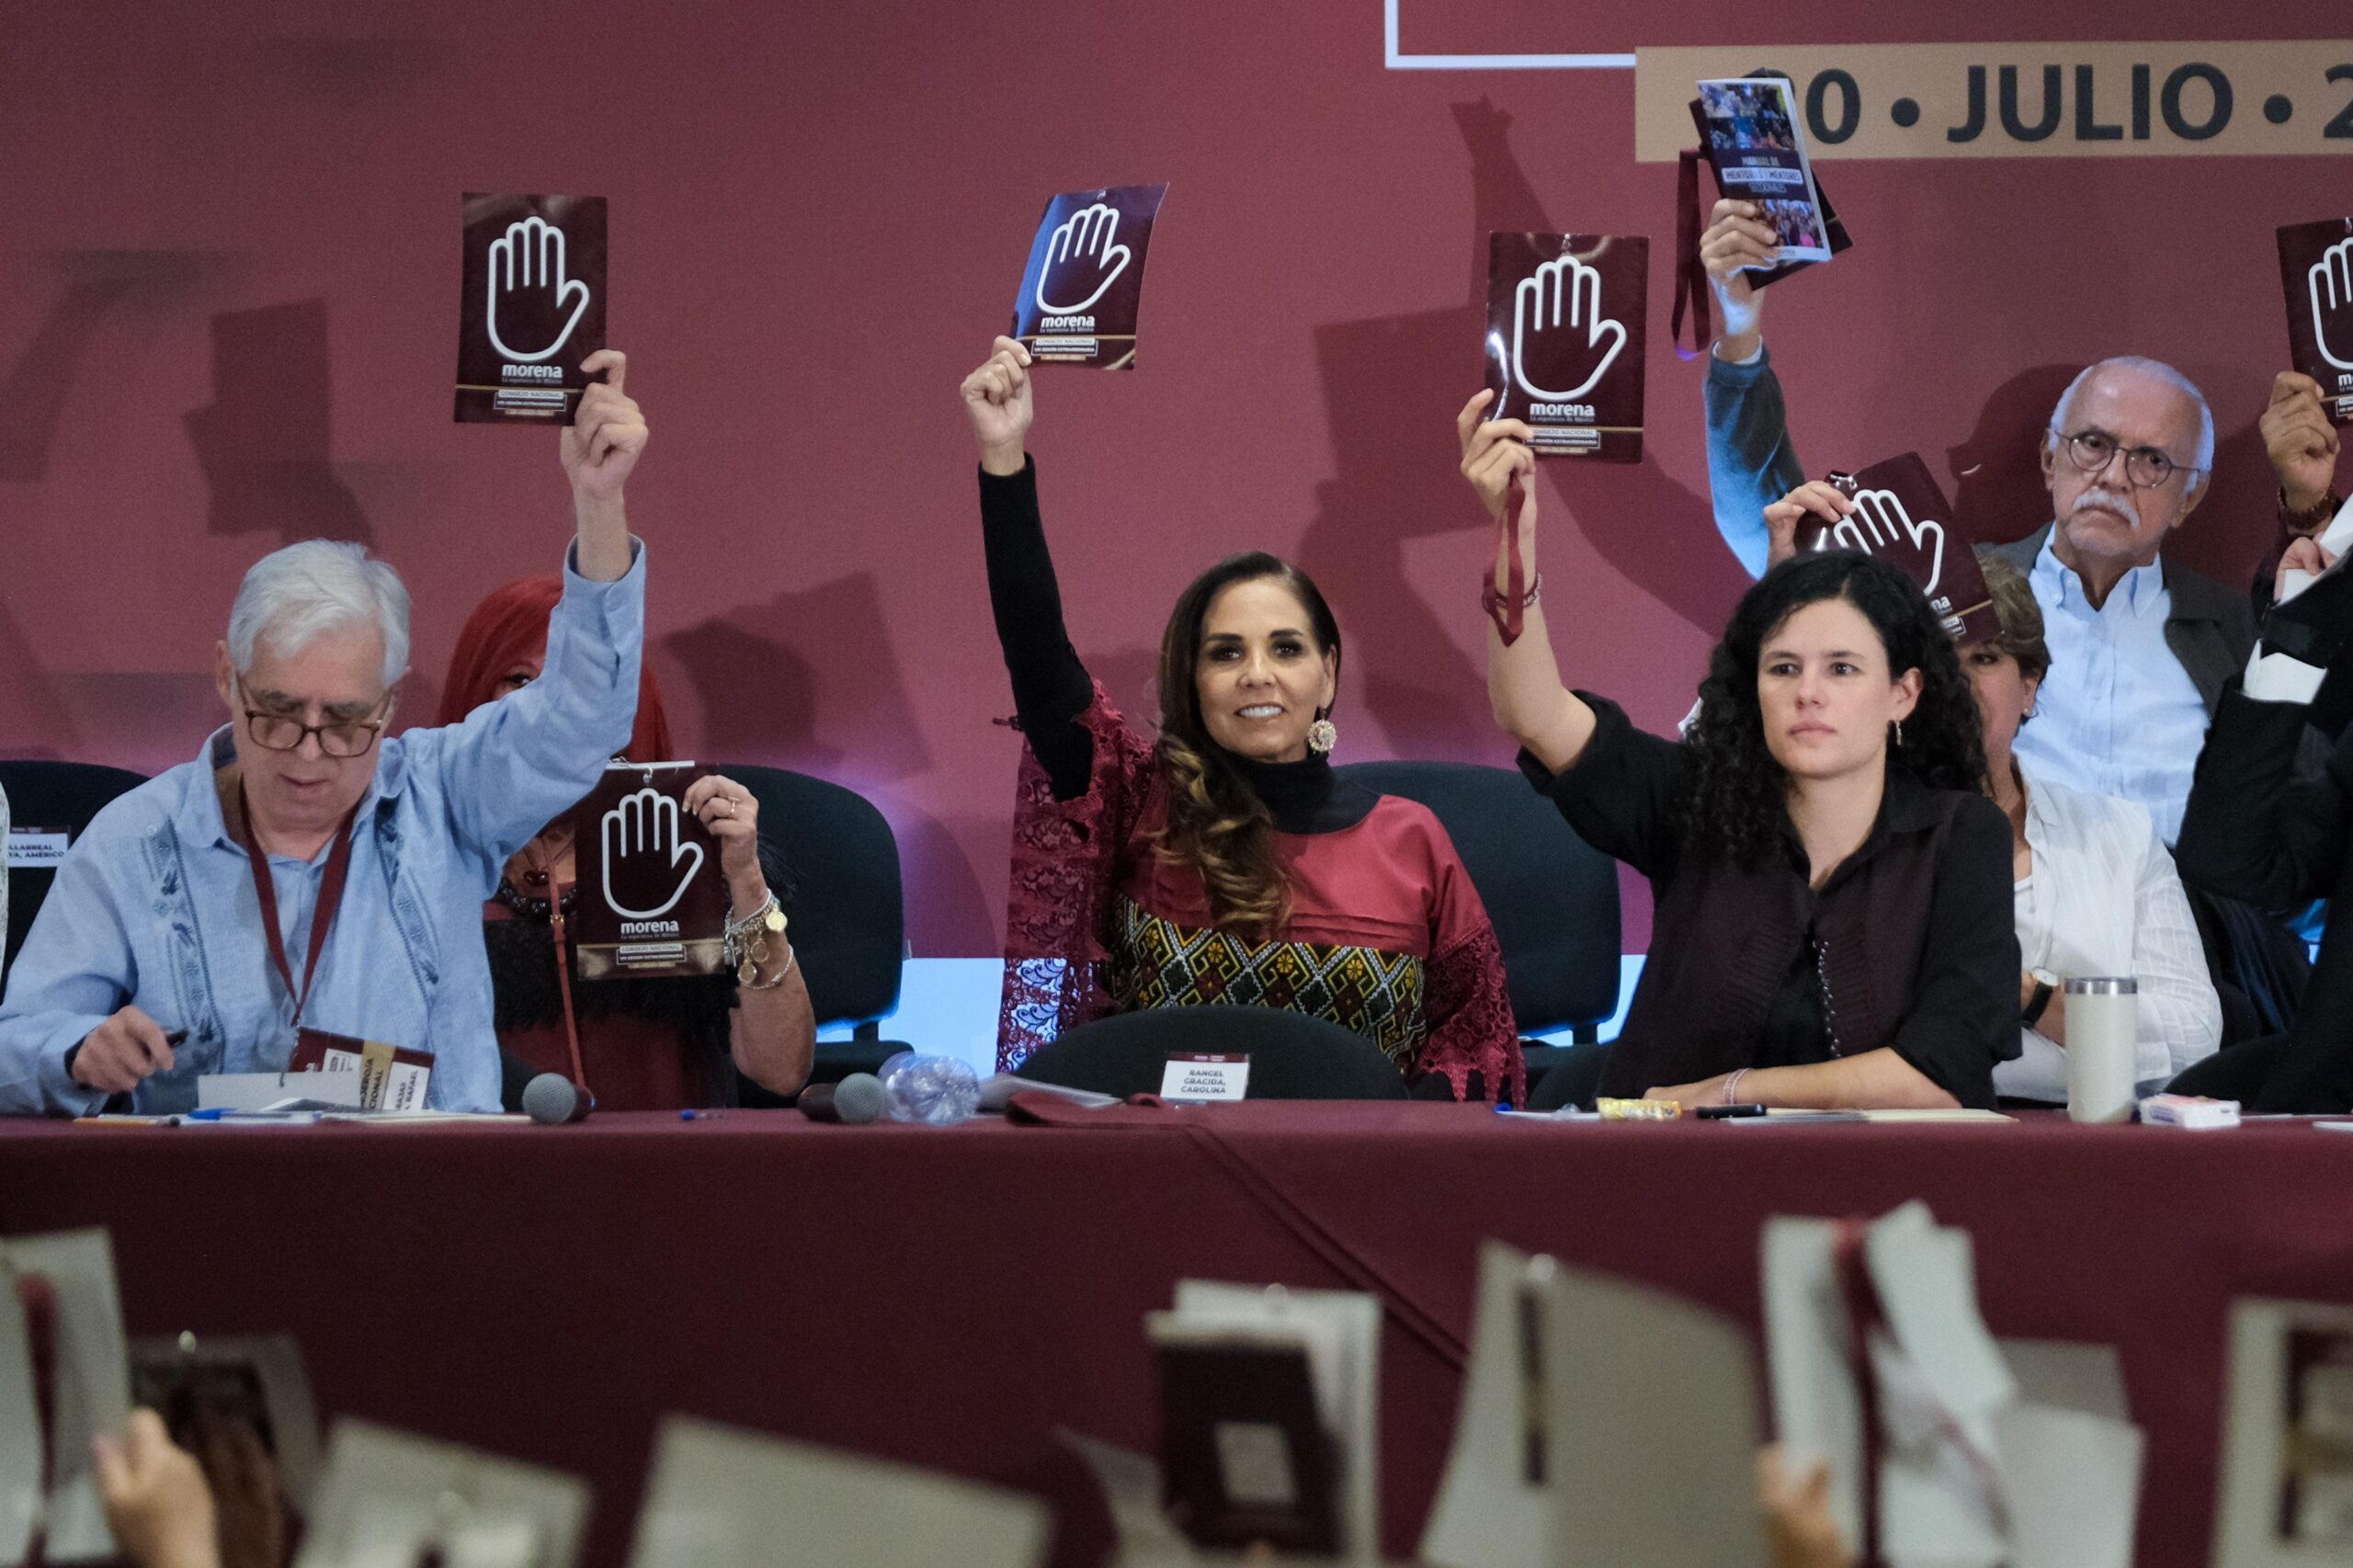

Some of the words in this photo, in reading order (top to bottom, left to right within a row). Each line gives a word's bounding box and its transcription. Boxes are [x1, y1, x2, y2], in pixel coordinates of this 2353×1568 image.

[1947, 62, 2234, 142] JULIO
[1040, 315, 1096, 328] morena
[502, 364, 563, 378] morena
[1529, 403, 1596, 416] morena
[620, 920, 680, 934] morena
[1188, 1069, 1224, 1077] RANGEL
[1183, 1077, 1226, 1086] GRACIDA,
[369, 1070, 383, 1109] CIONAL
[1180, 1085, 1226, 1094] CAROLINA
